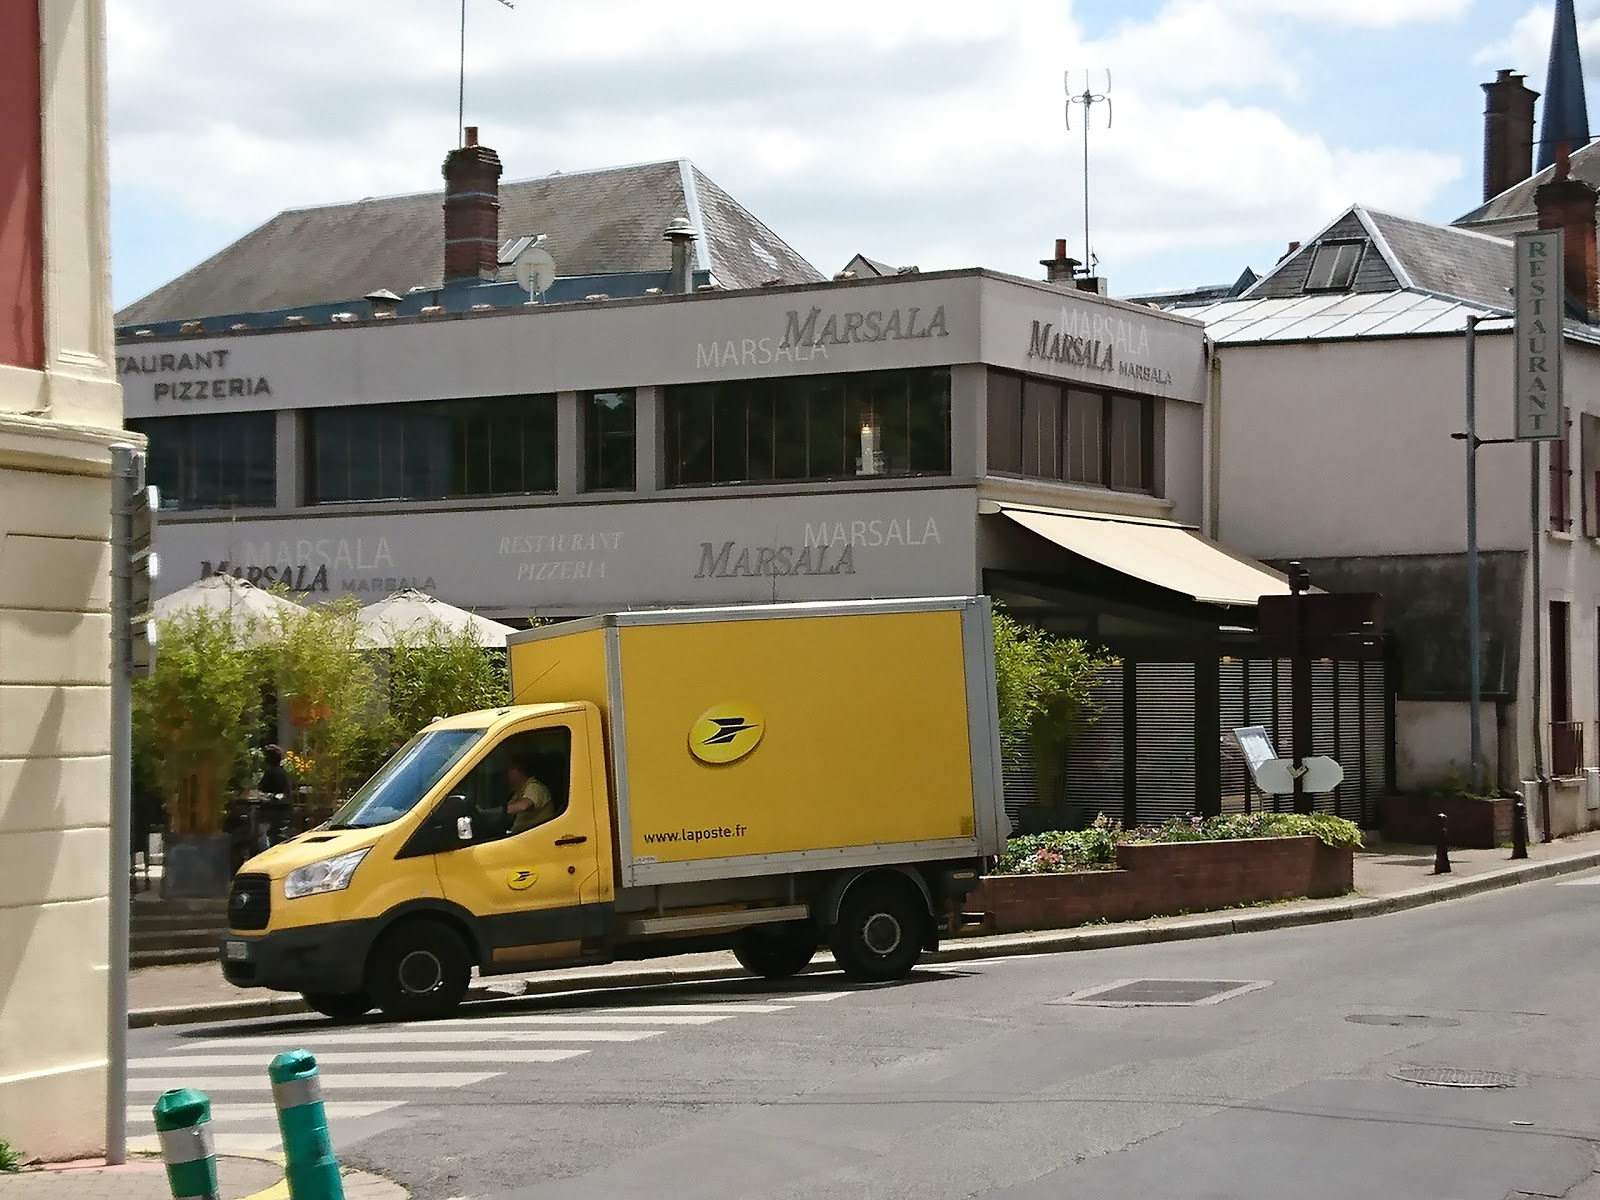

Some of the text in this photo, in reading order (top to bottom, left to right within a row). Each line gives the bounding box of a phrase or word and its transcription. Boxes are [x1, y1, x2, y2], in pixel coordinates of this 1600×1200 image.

[779, 305, 949, 349] MARSALA
[1061, 305, 1150, 355] MARSALA
[1528, 241, 1547, 431] RESTAURANT
[696, 334, 829, 369] MARSALA
[1027, 319, 1115, 374] MARSALA
[154, 376, 272, 401] PIZZERIA
[803, 517, 941, 548] MARSALA
[244, 536, 395, 572] MARSALA
[694, 541, 856, 578] MARSALA
[644, 824, 747, 844] www.laposte.fr
